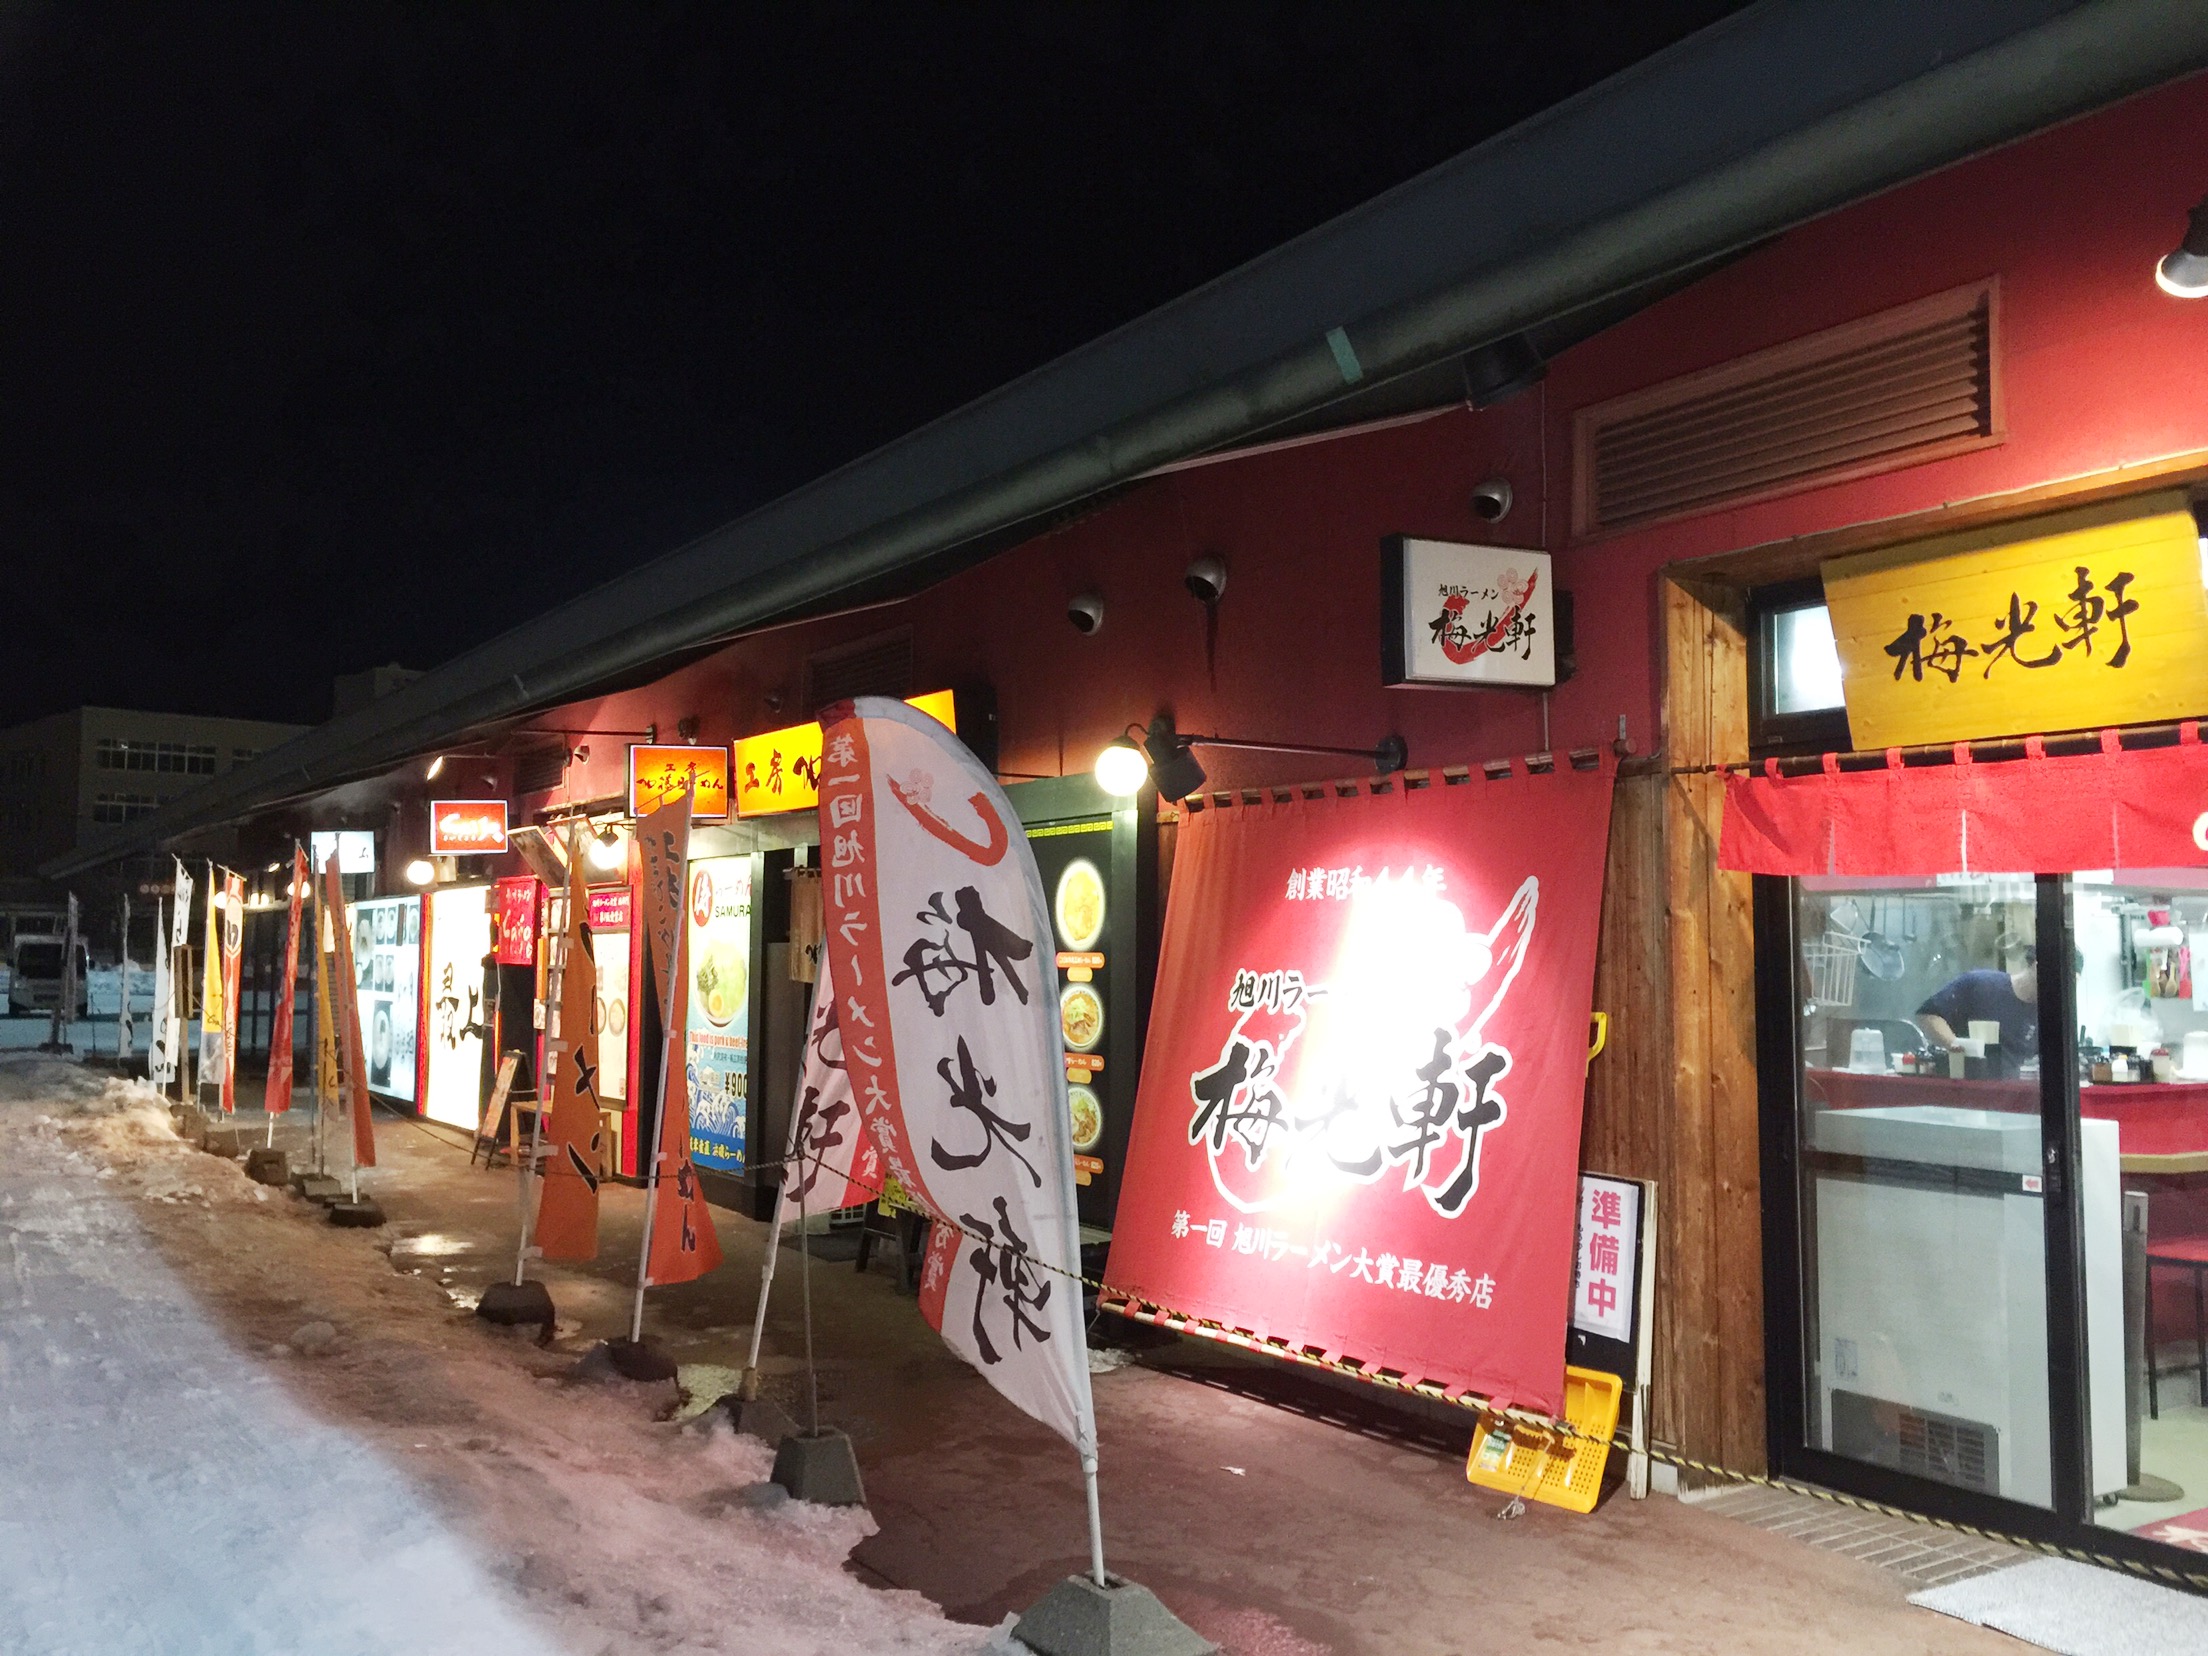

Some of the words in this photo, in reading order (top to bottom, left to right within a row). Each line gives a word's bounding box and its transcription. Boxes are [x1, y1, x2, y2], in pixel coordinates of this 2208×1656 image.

[1429, 605, 1536, 660] 梅光軒
[1438, 583, 1499, 600] 旭川ラーメン
[1884, 567, 2140, 683] 梅光軒
[1193, 1028, 1507, 1212] 梅光軒
[1171, 1209, 1226, 1249] 第一回
[1232, 1221, 1497, 1310] 旭川ラーメン大賞最優秀店
[1588, 1189, 1621, 1318] 準備中
